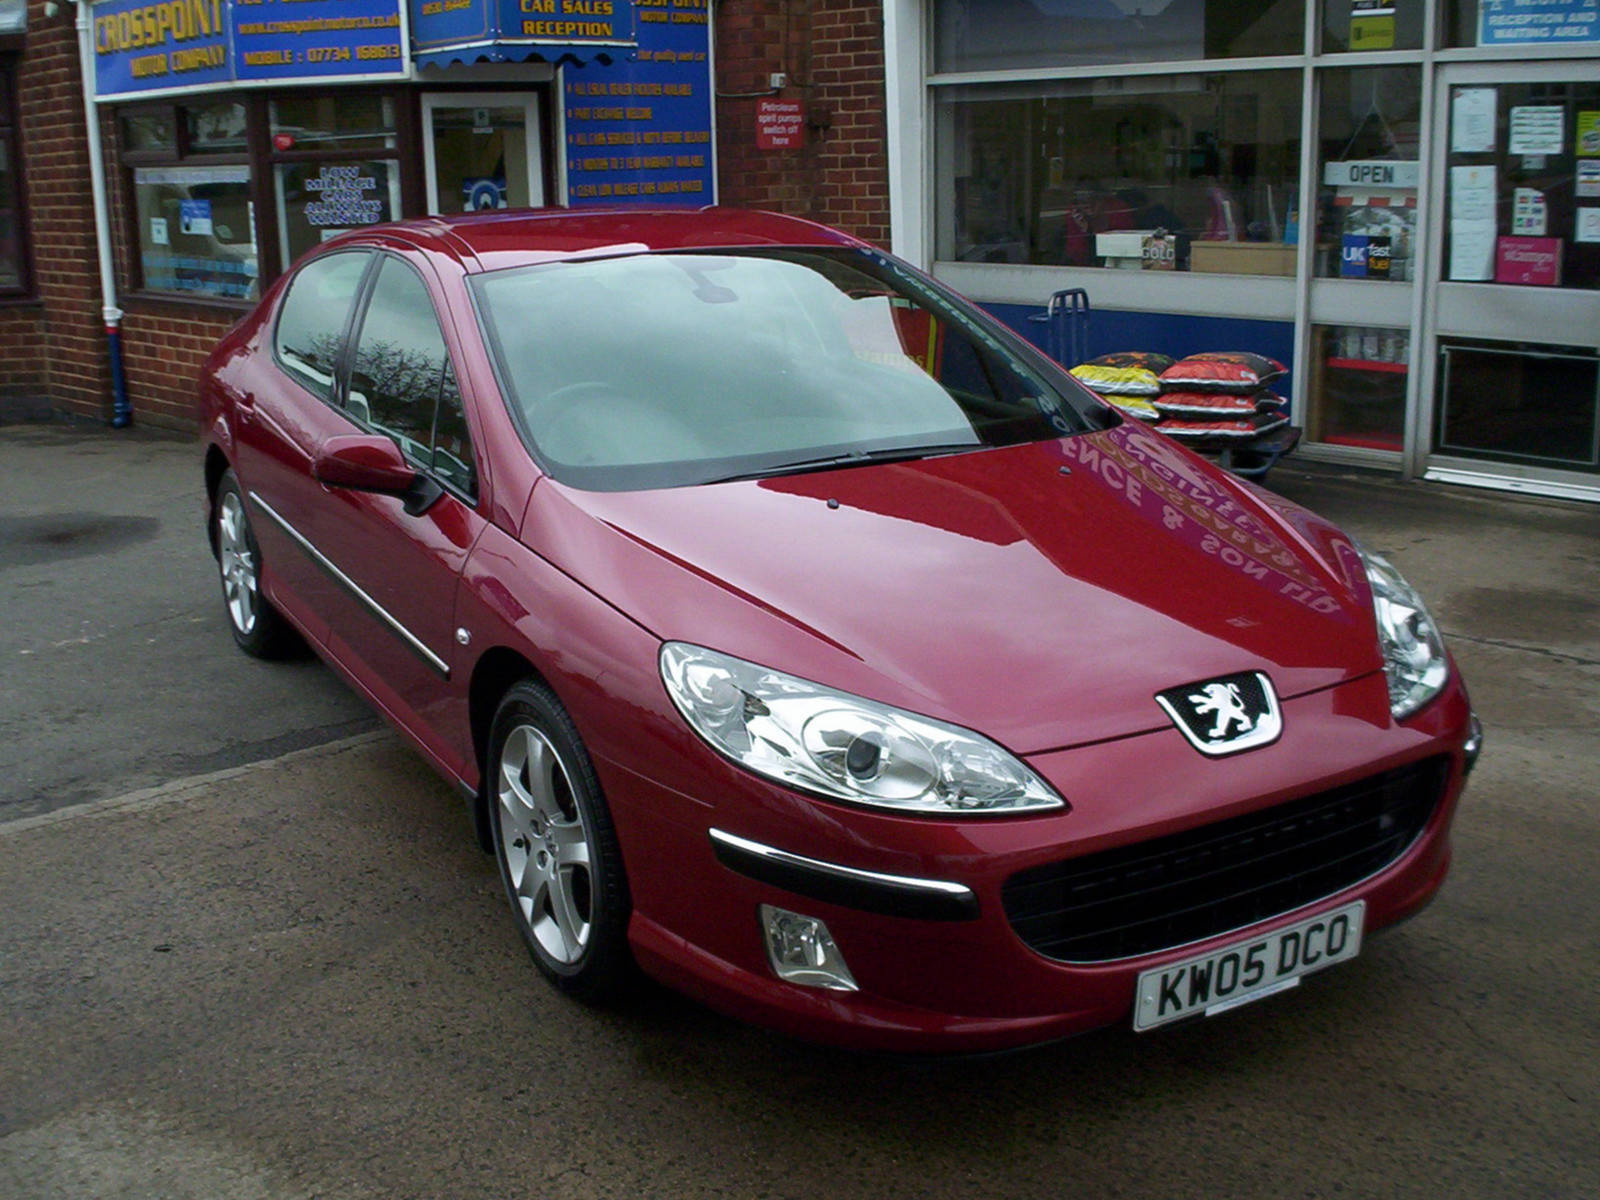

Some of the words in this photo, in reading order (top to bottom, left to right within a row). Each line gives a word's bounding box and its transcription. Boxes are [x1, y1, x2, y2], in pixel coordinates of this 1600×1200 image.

[520, 0, 555, 14] CAR
[562, 0, 614, 15] SALES
[1489, 13, 1565, 26] RECEPTION
[1566, 12, 1598, 23] AND
[95, 0, 223, 53] CROSSPOINT
[522, 20, 613, 36] RECEPTION
[1494, 27, 1551, 39] WAITING
[1552, 26, 1590, 37] AREA
[130, 54, 167, 76] MOTOR
[171, 45, 226, 72] COMPANY
[244, 50, 292, 65] MOBILE
[307, 47, 351, 62] 07734
[761, 102, 799, 113] Petroleum
[777, 114, 802, 124] pumps
[772, 136, 789, 145] here
[320, 166, 360, 179] LOW
[1350, 165, 1394, 183] OPEN
[305, 177, 377, 191] MILEAGE
[320, 189, 363, 202] CARS
[307, 212, 380, 226] WANTED
[1141, 247, 1175, 260] GOLD
[1343, 246, 1366, 262] UK
[1367, 242, 1391, 257] fast
[1157, 942, 1267, 1017] KW05
[1274, 913, 1349, 977] DCO
